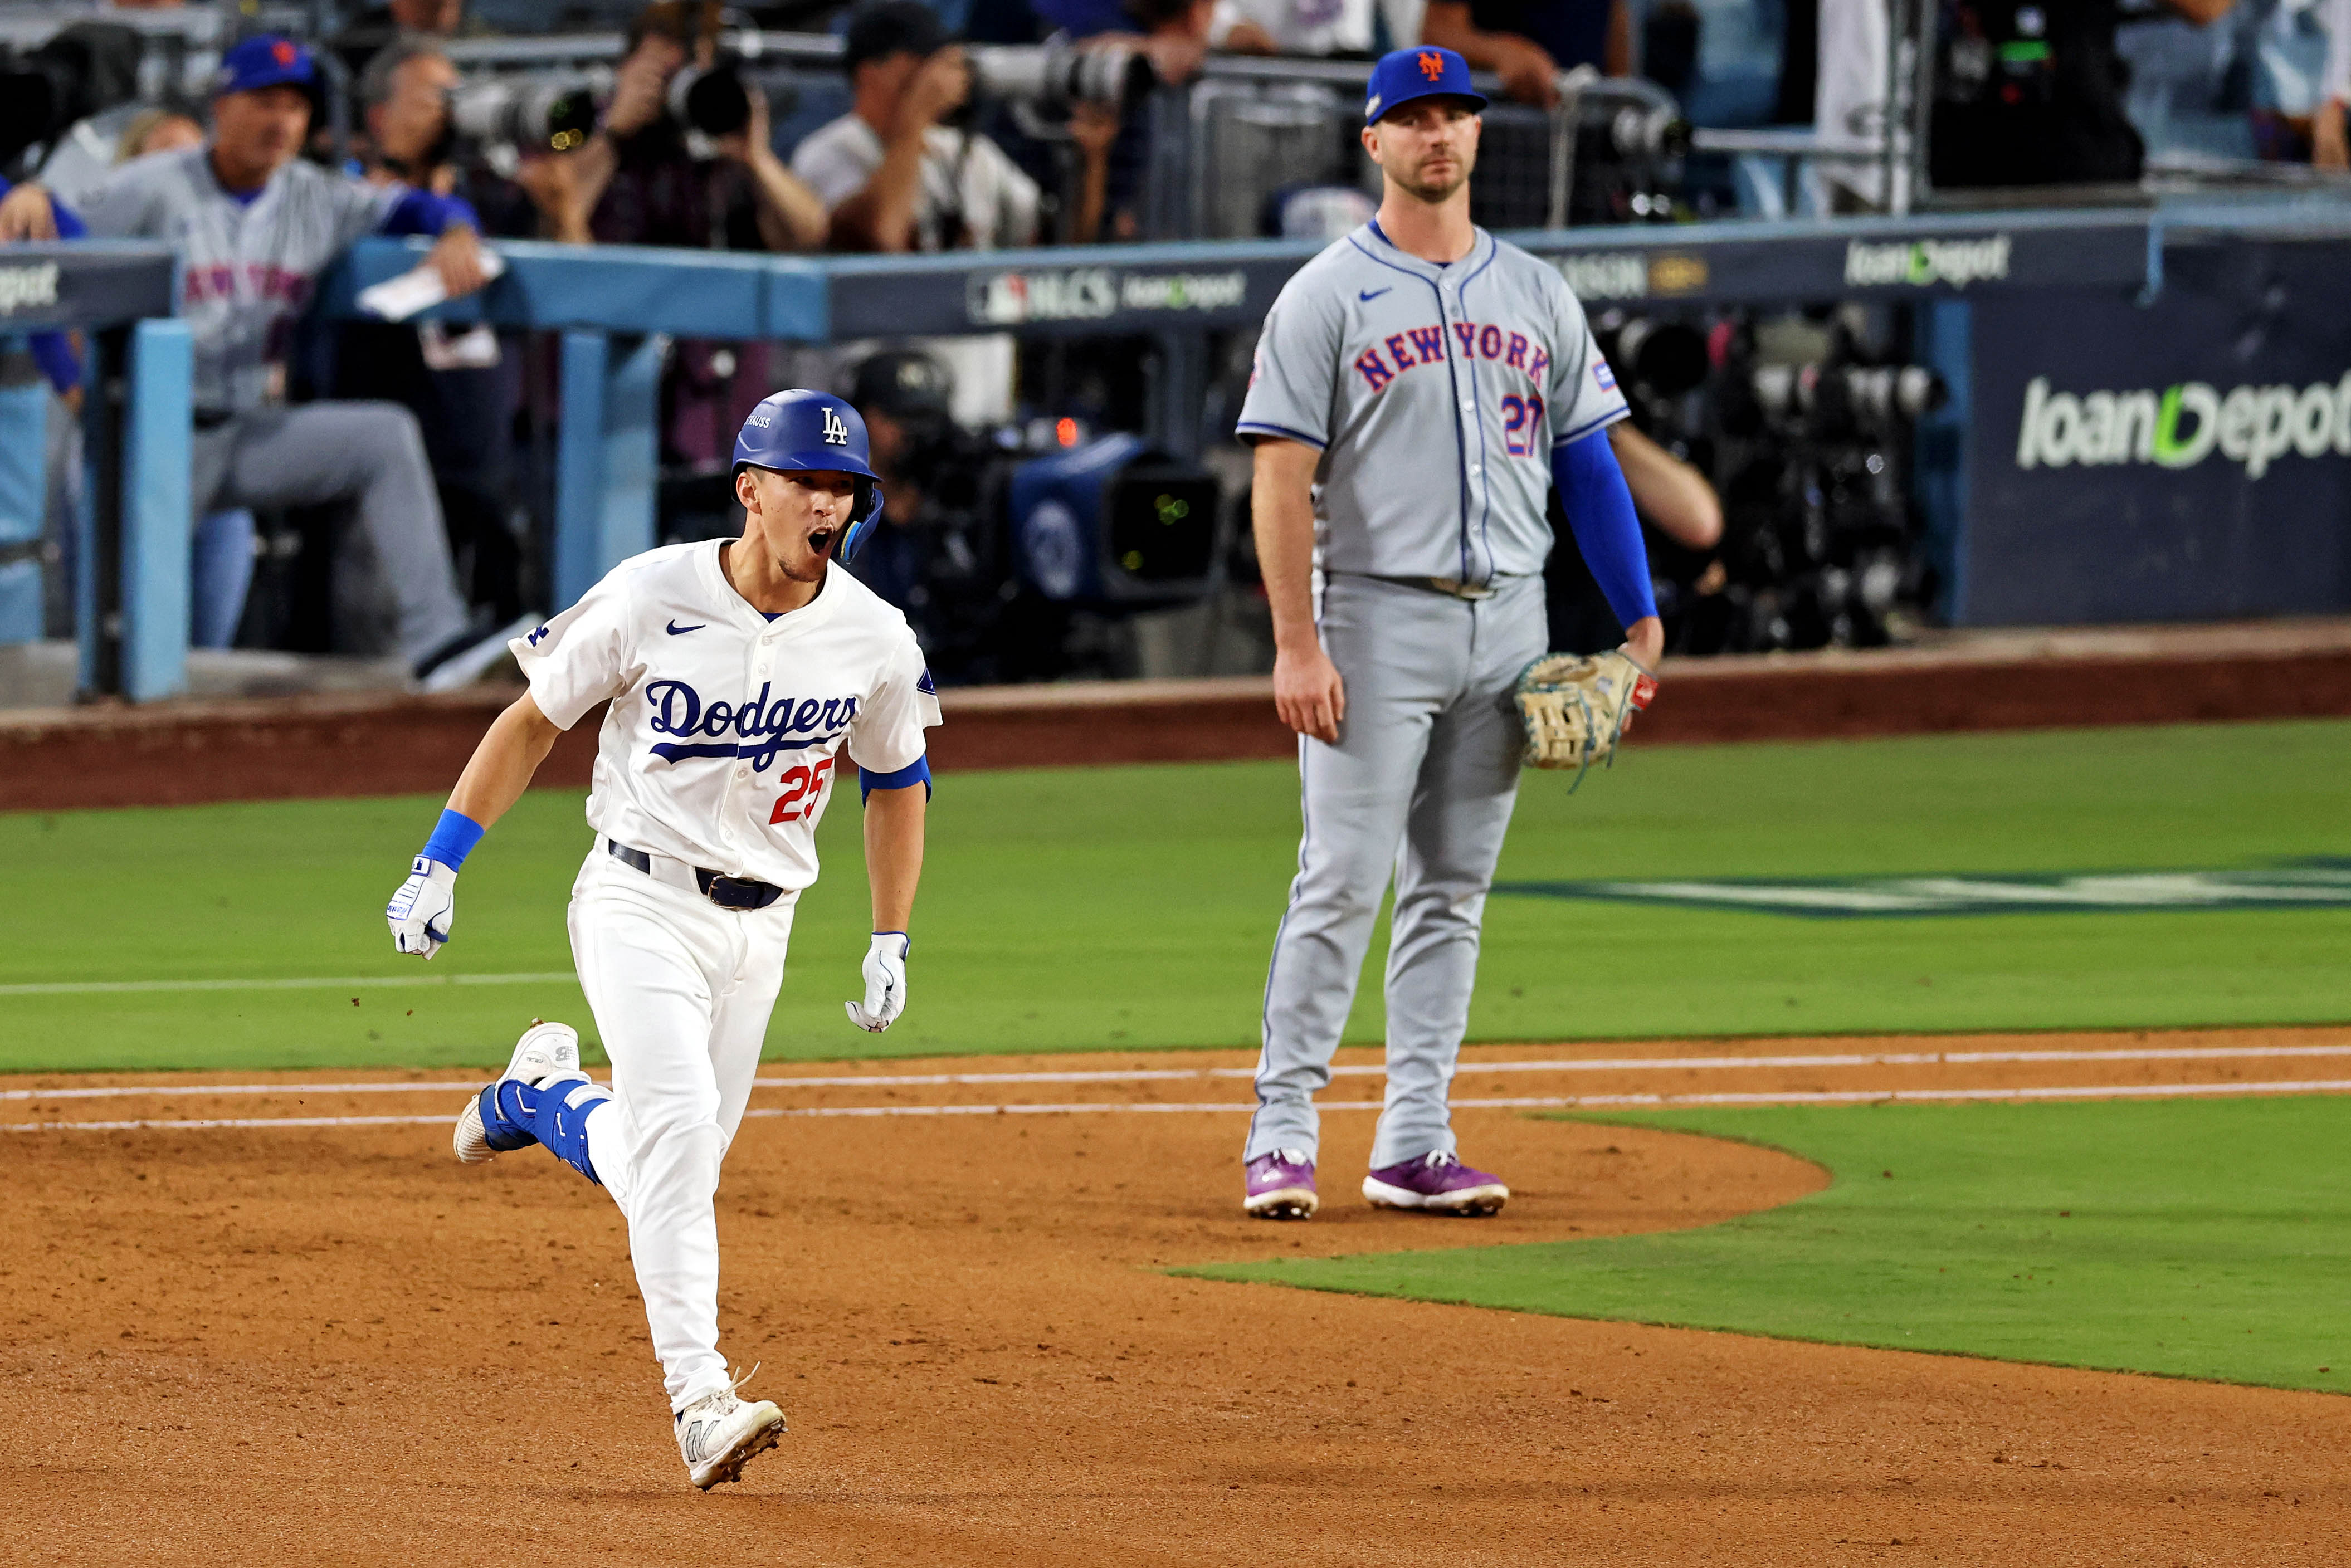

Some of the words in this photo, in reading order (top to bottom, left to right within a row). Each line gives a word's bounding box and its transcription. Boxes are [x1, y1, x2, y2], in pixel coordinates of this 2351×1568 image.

[1418, 52, 1444, 81] NY
[1845, 232, 2012, 290] loanDepot
[1354, 325, 1445, 393] NEW
[1453, 322, 1549, 389] YORK
[822, 407, 847, 445] LA
[1501, 393, 1544, 458] 27
[645, 680, 856, 773] Dodgers
[769, 756, 835, 825] 25
